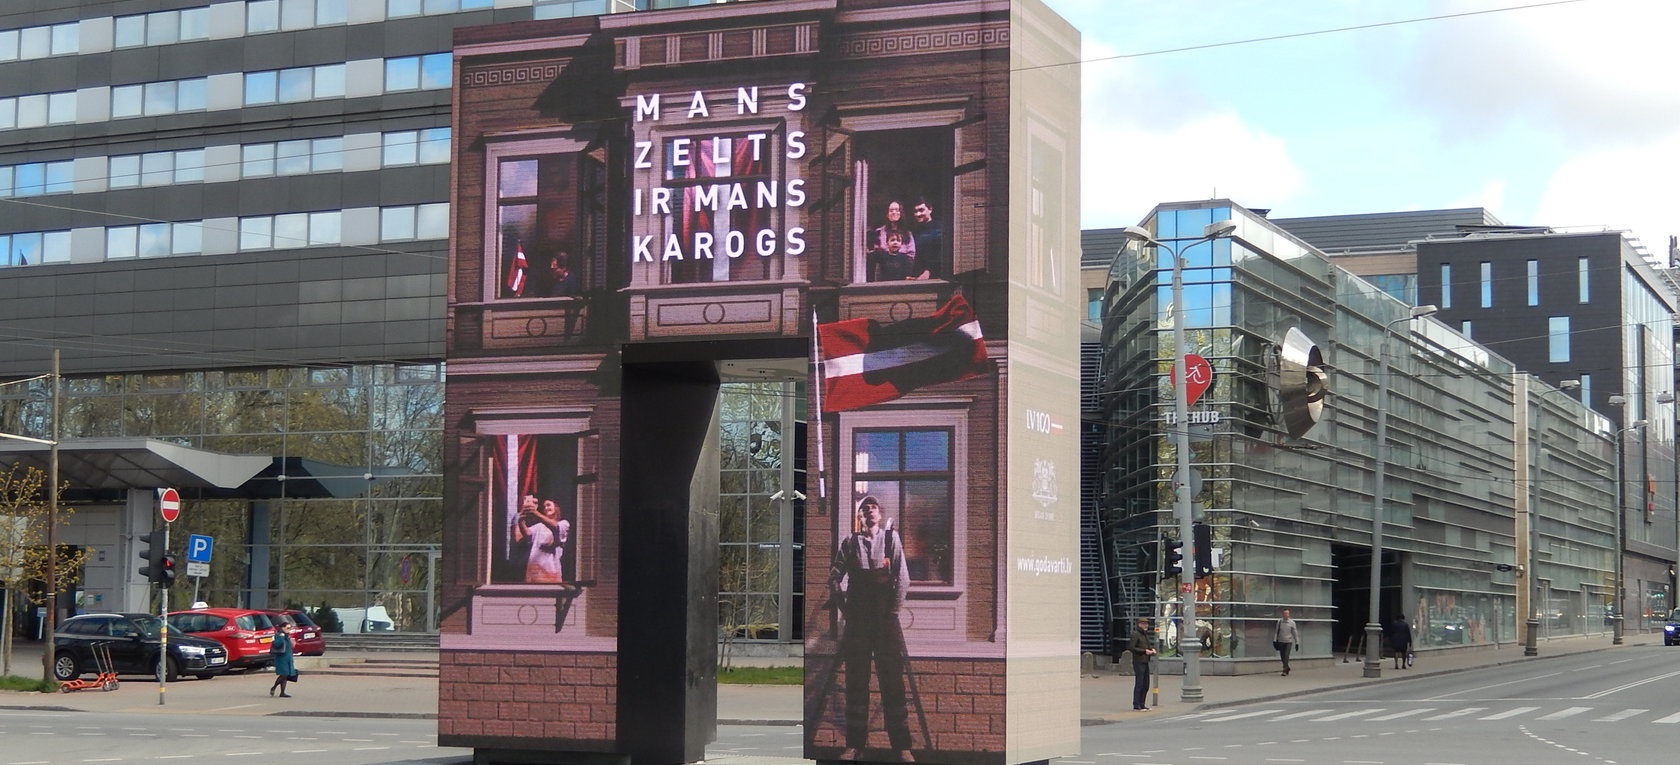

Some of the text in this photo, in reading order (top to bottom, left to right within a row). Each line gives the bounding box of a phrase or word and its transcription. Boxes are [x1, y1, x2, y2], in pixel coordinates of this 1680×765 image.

[636, 83, 806, 122] MANS
[634, 131, 806, 169] ZELTS
[635, 179, 806, 216] IR MANS
[633, 227, 806, 262] KAROGS
[1193, 411, 1220, 423] HUB
[193, 538, 207, 558] P
